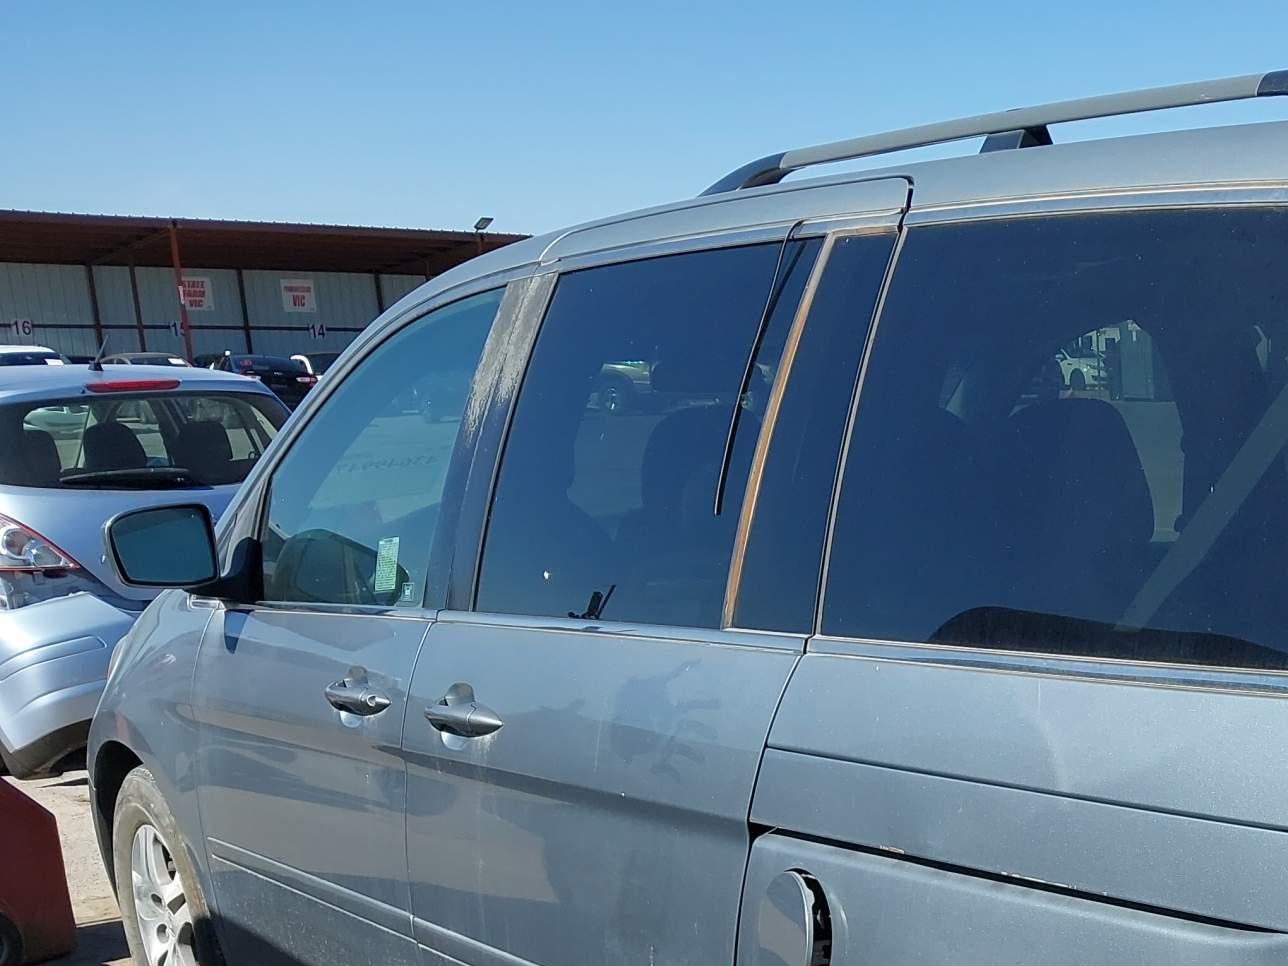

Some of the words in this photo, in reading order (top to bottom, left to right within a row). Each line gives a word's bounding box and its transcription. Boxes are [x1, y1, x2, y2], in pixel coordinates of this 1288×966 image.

[188, 299, 204, 308] VIC
[292, 294, 306, 307] VIC
[11, 319, 32, 336] 16
[309, 323, 326, 339] 14
